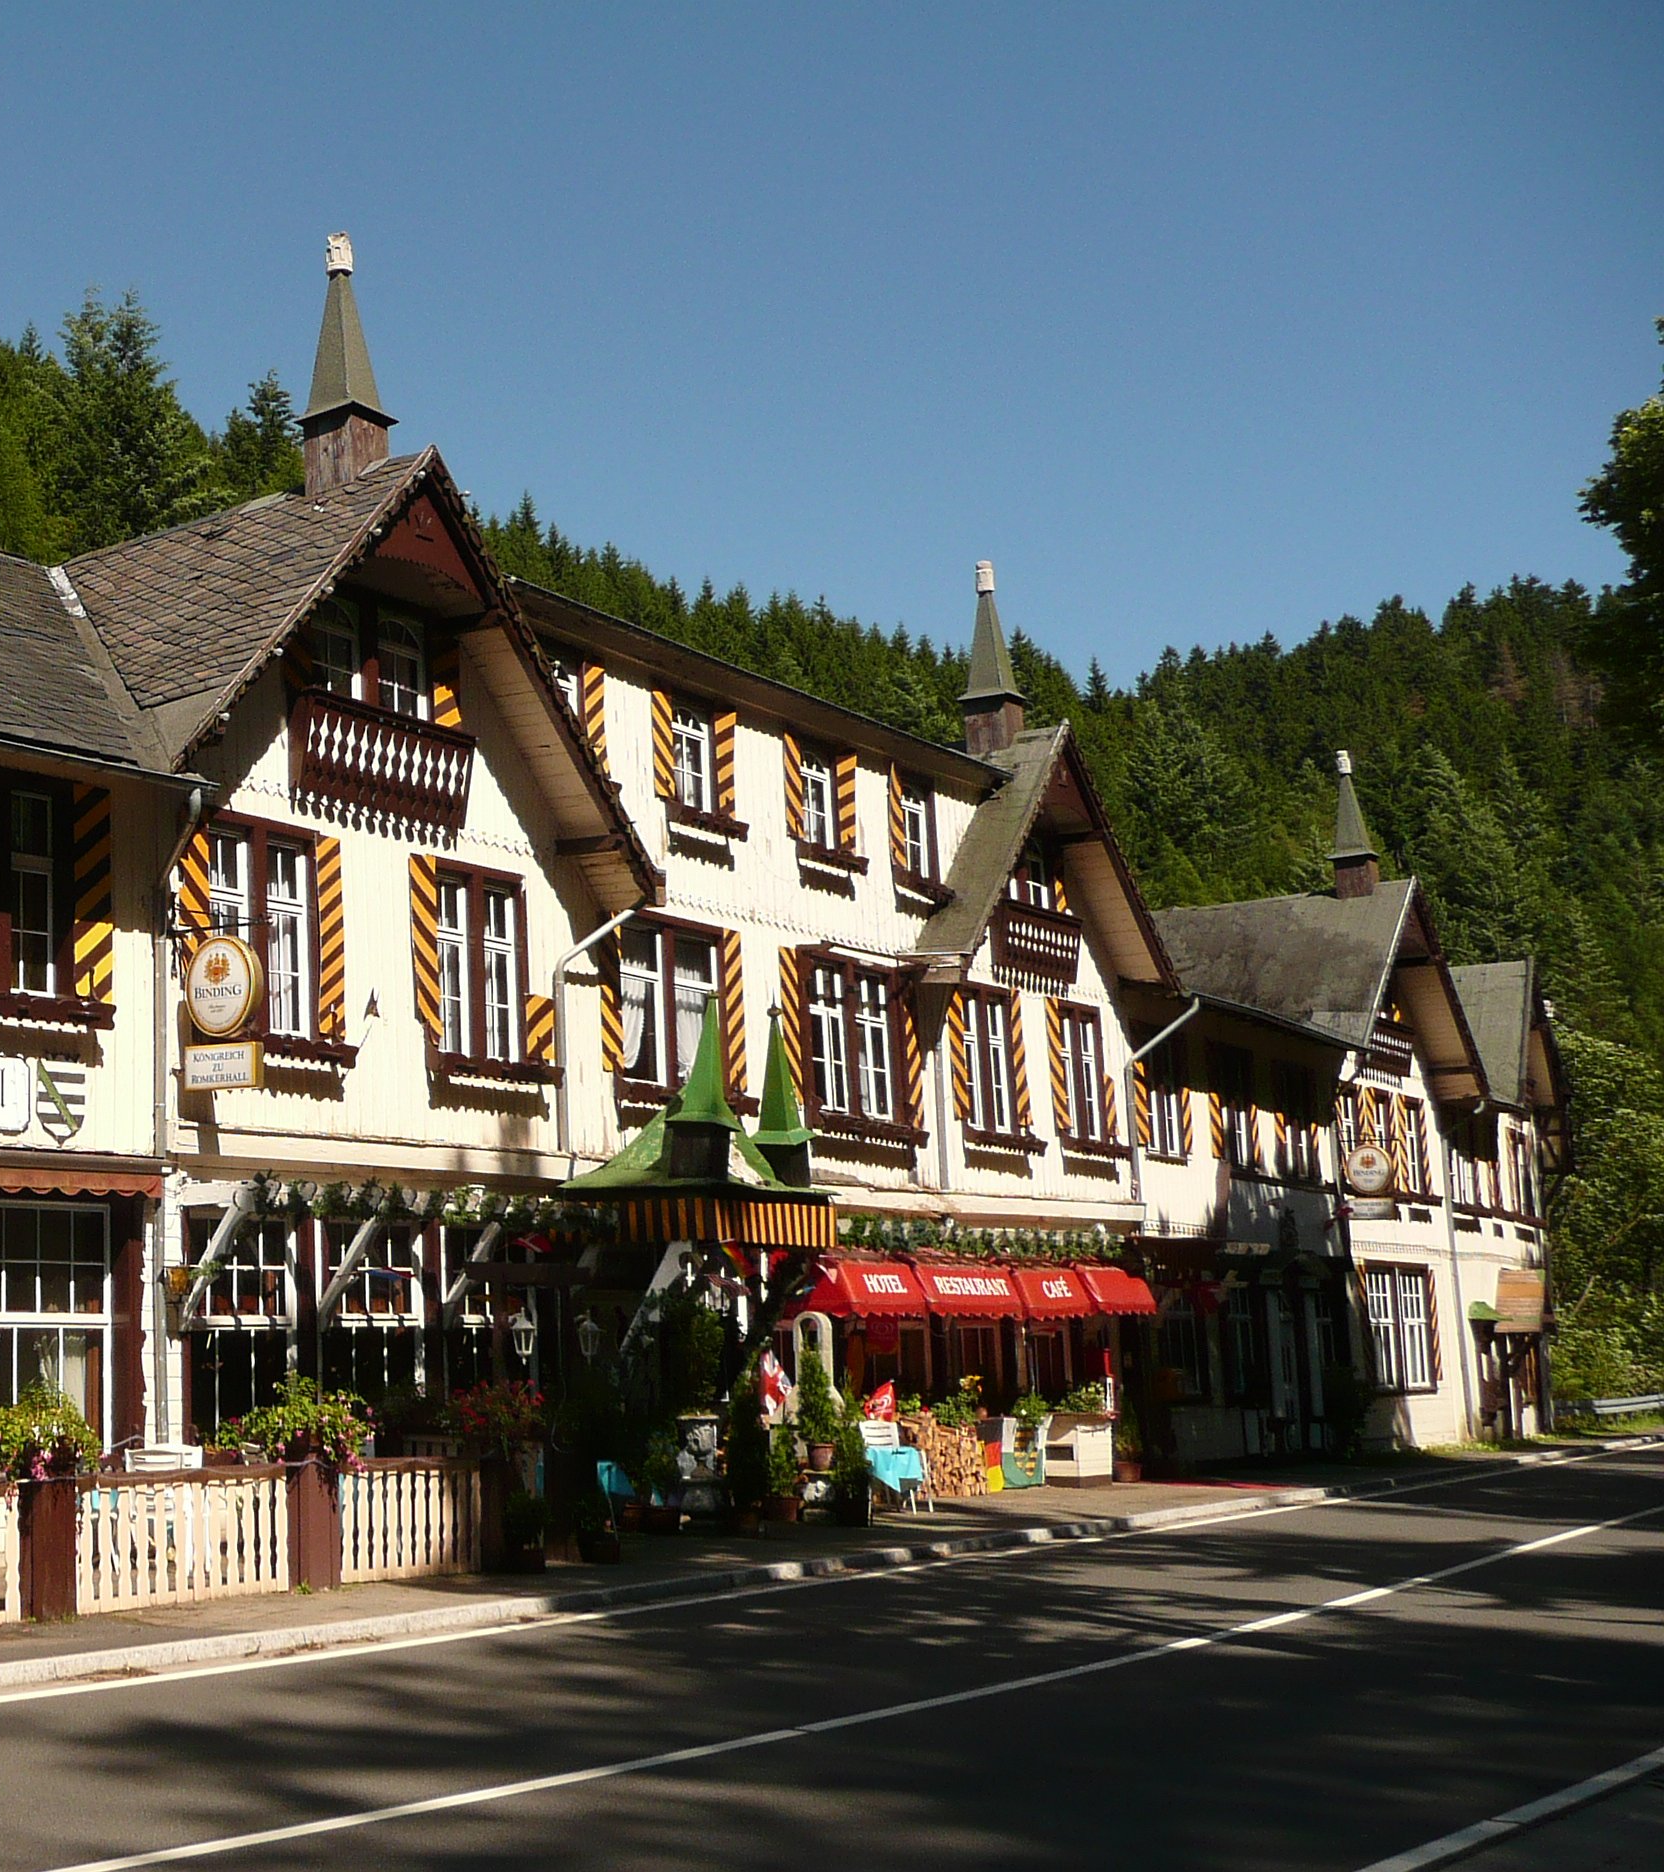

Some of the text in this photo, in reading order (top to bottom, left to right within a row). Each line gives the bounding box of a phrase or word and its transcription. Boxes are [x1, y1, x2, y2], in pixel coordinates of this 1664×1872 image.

[194, 984, 242, 999] BINDING
[213, 1063, 223, 1072] ZU
[192, 1072, 248, 1084] ROMKERHALL
[863, 1274, 1072, 1298] HOTEL RESTAURANT CAFÉ
